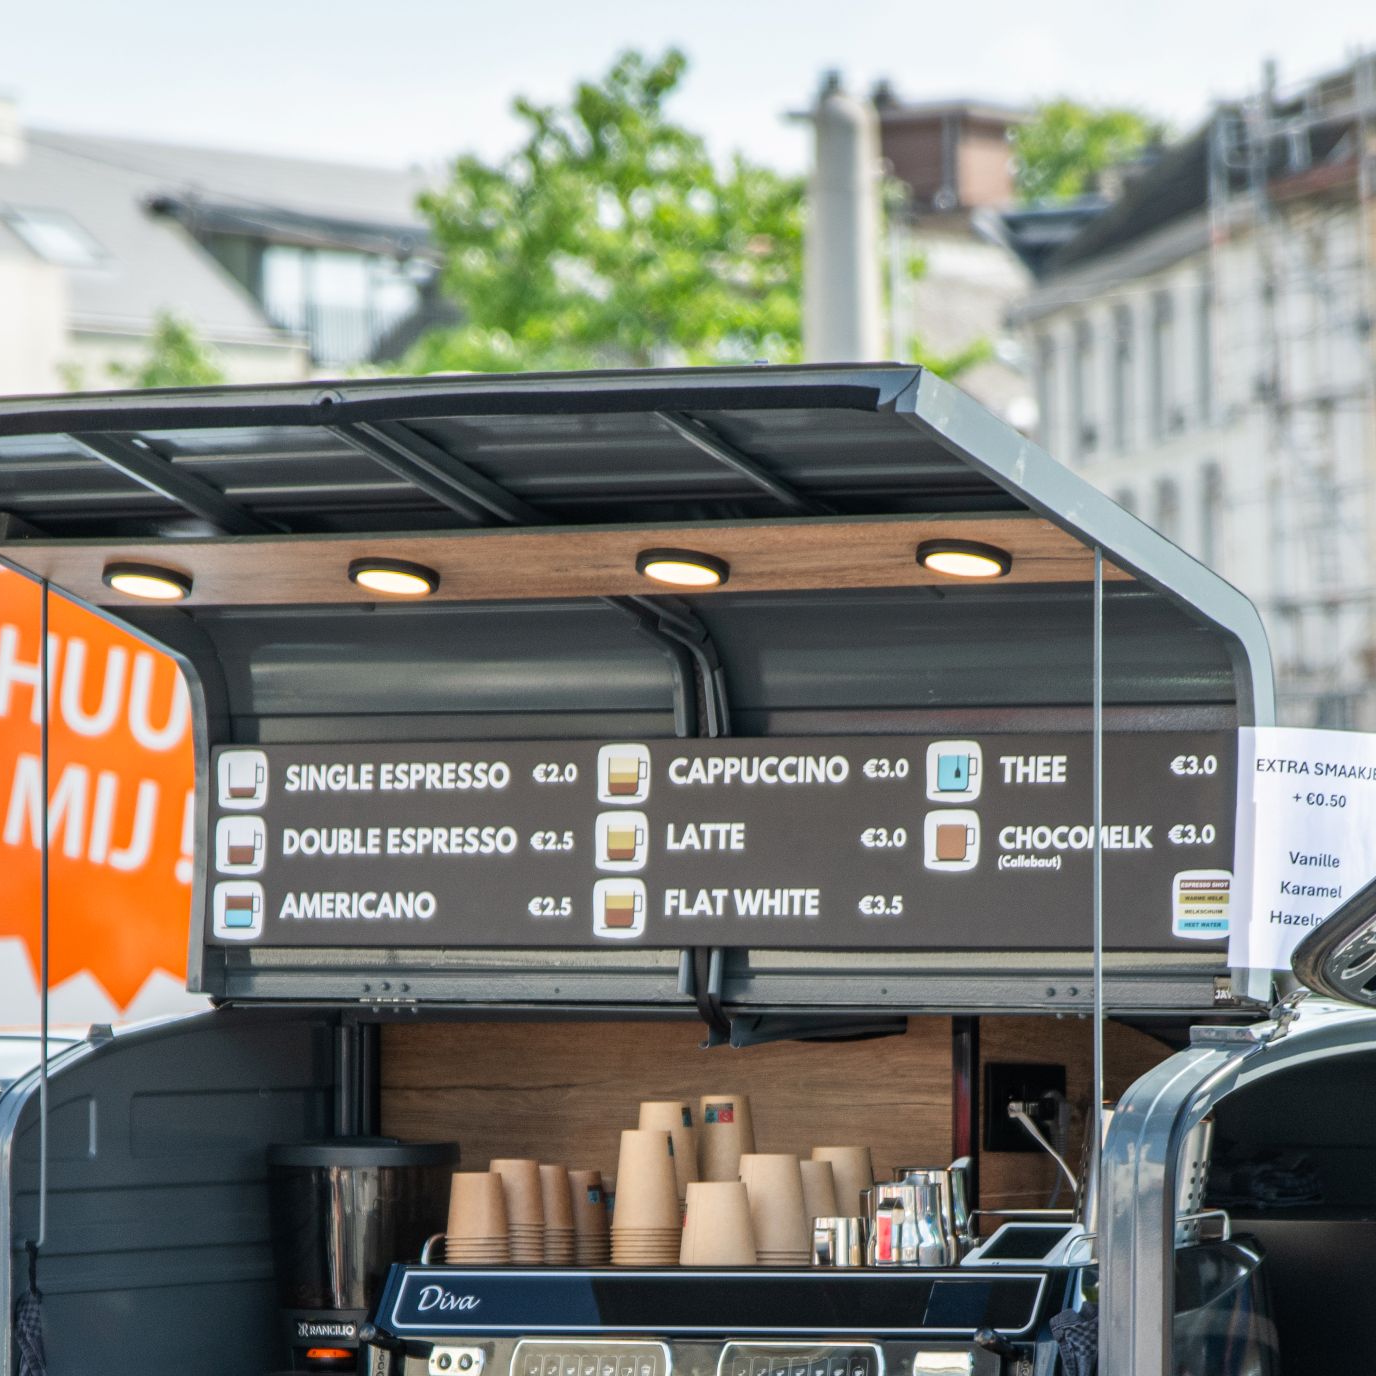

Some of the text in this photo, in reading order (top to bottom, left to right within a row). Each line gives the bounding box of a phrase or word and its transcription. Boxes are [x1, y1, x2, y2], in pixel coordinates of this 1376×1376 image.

[284, 761, 578, 793] SINGLE ESPRESSO €2.0
[668, 755, 910, 786] CAPPUCCINO €3.0
[999, 754, 1218, 784] THEE €3.0
[1255, 758, 1310, 775] EXTRA
[2, 753, 159, 873] MIJ
[1306, 792, 1347, 808] €0.50
[282, 826, 575, 857] DOUBLE ESPRESSO €2.5
[666, 822, 908, 852] LATTE €3.0
[998, 823, 1216, 851] CHOCOMELK €3.0
[997, 854, 1062, 871] (Callebaut)
[1289, 851, 1341, 868] Vanille
[1180, 881, 1229, 889] ESPRESSO SHOT
[1280, 881, 1342, 898] Karamel
[278, 891, 573, 921] AMERICANO €2.5
[664, 888, 905, 918] FLAT WHITE €3.5
[417, 1284, 481, 1312] Diva
[309, 1324, 355, 1337] RANCILIO
